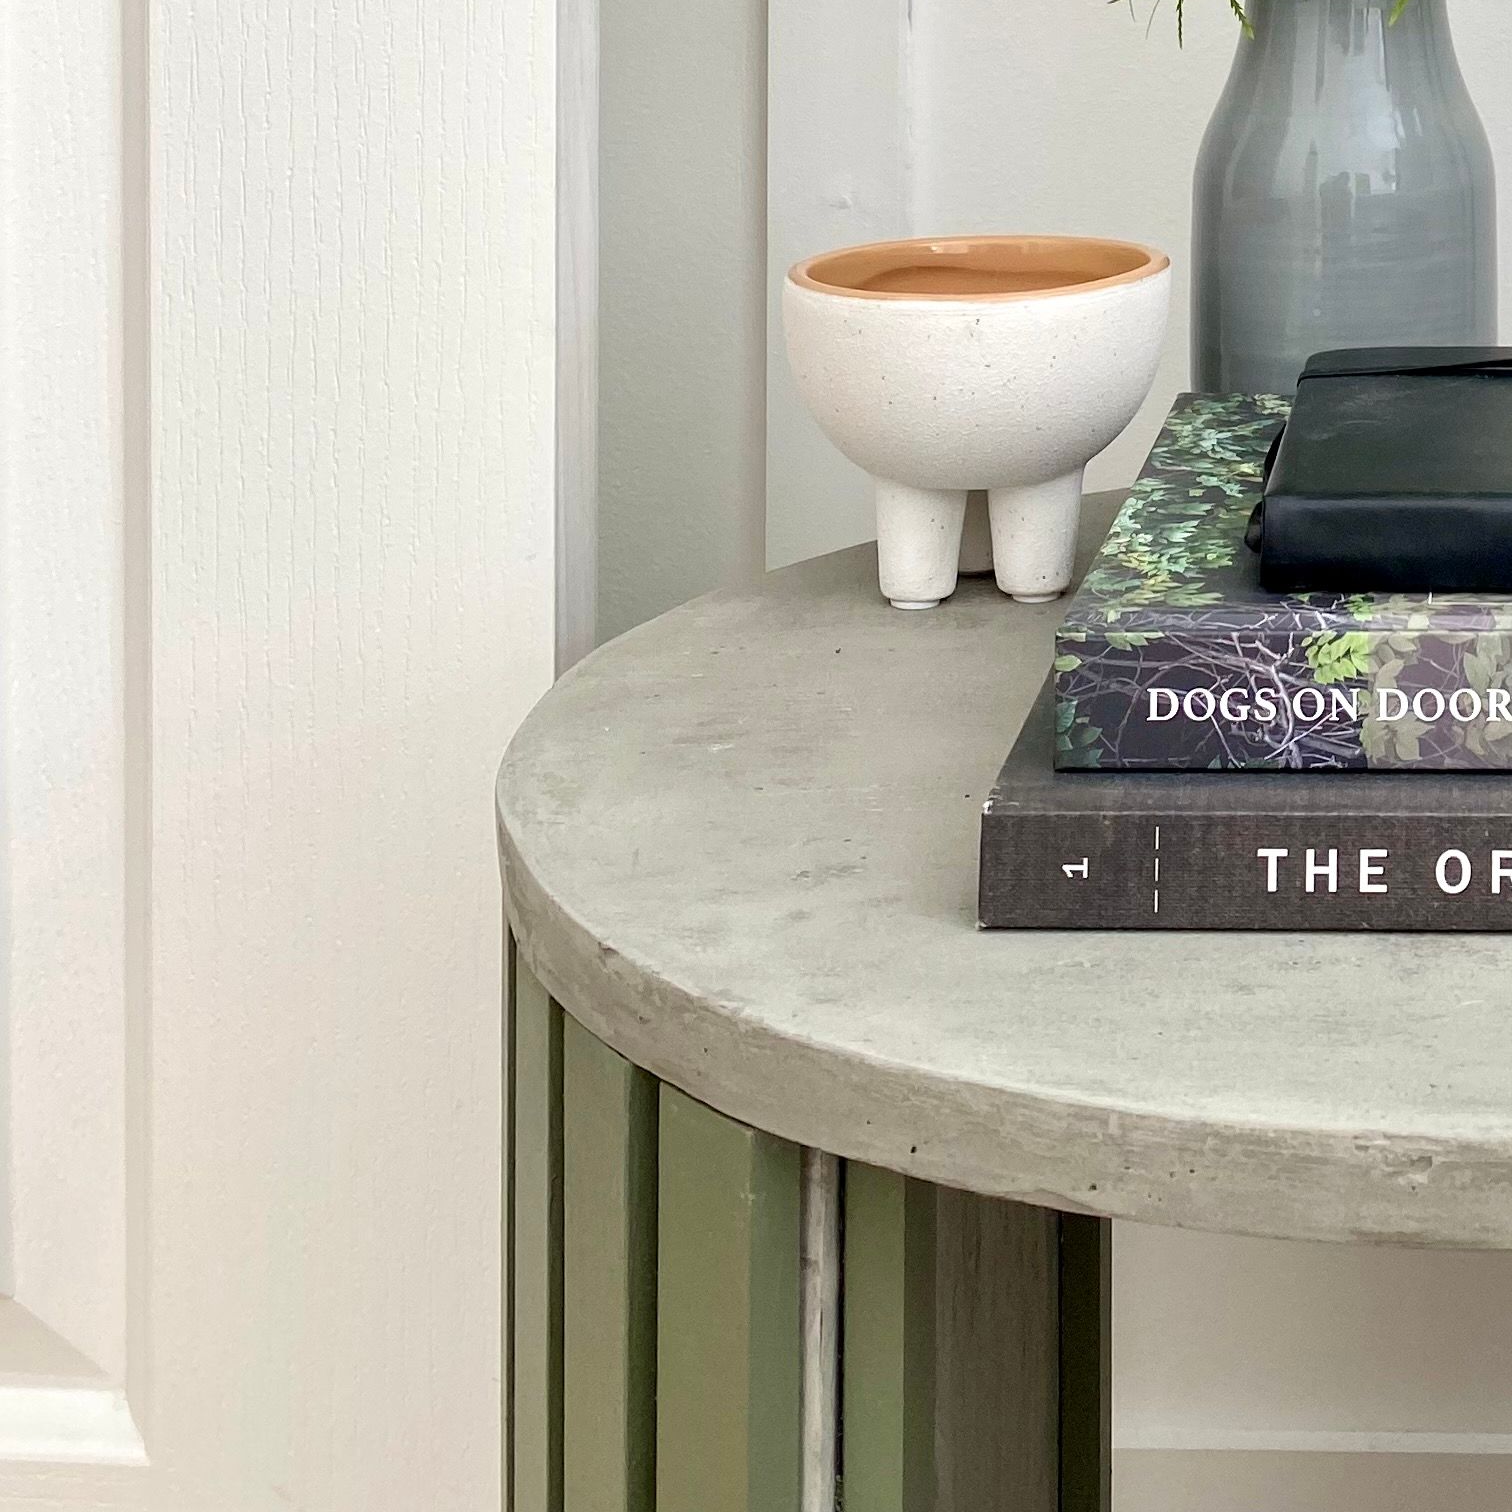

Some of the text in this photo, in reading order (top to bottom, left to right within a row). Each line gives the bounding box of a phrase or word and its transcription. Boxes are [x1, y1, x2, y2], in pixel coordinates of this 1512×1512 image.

[1147, 688, 1278, 722] DOGS
[1292, 688, 1361, 722] ON
[1061, 857, 1088, 879] 1
[1257, 848, 1388, 893] THE
